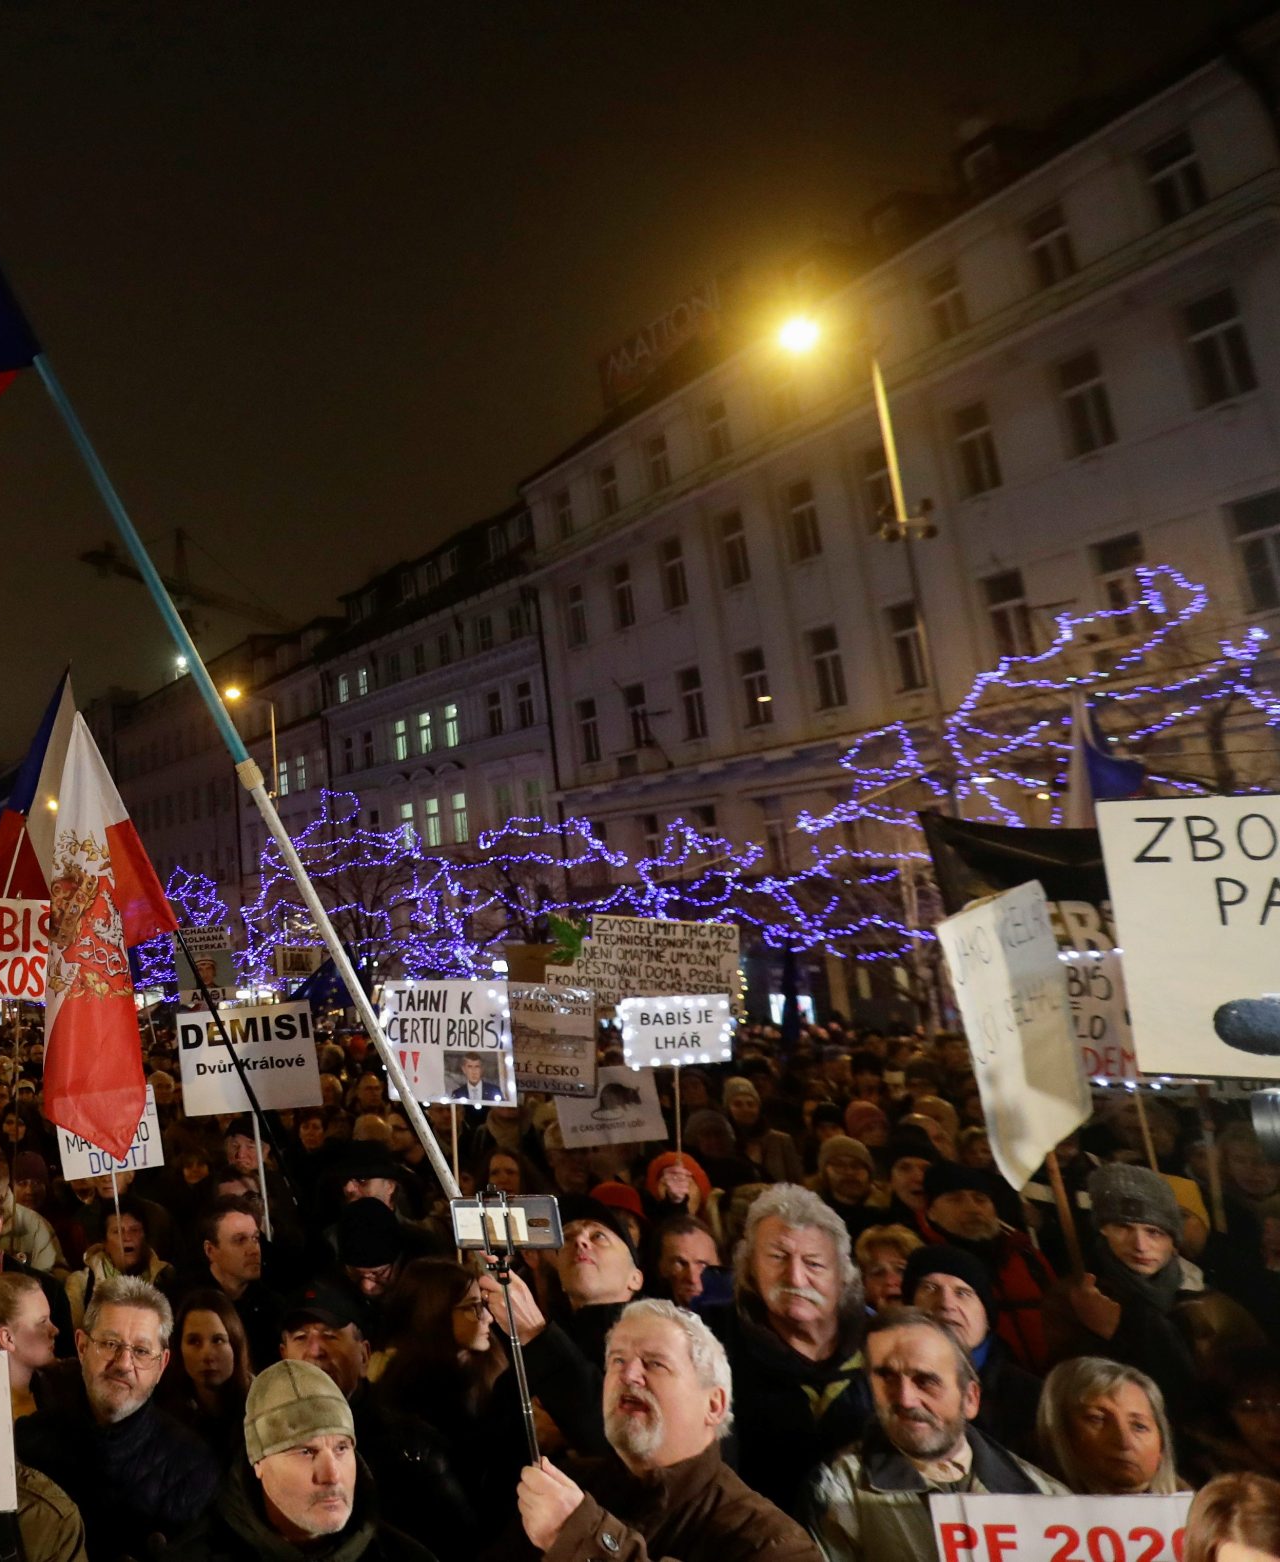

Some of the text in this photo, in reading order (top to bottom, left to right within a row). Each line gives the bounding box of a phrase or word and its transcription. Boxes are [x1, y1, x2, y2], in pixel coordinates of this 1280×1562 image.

[681, 924, 706, 937] THC
[710, 925, 736, 939] PRO
[394, 985, 473, 1014] TÁHNI K
[640, 1007, 714, 1026] BABIŠ JE
[181, 1013, 310, 1050] DEMISI
[388, 1012, 440, 1045] ČERTU
[655, 1032, 701, 1050] LHÁŘ
[196, 1053, 306, 1075] Dvůr Králové
[536, 1061, 580, 1077] ČESKO
